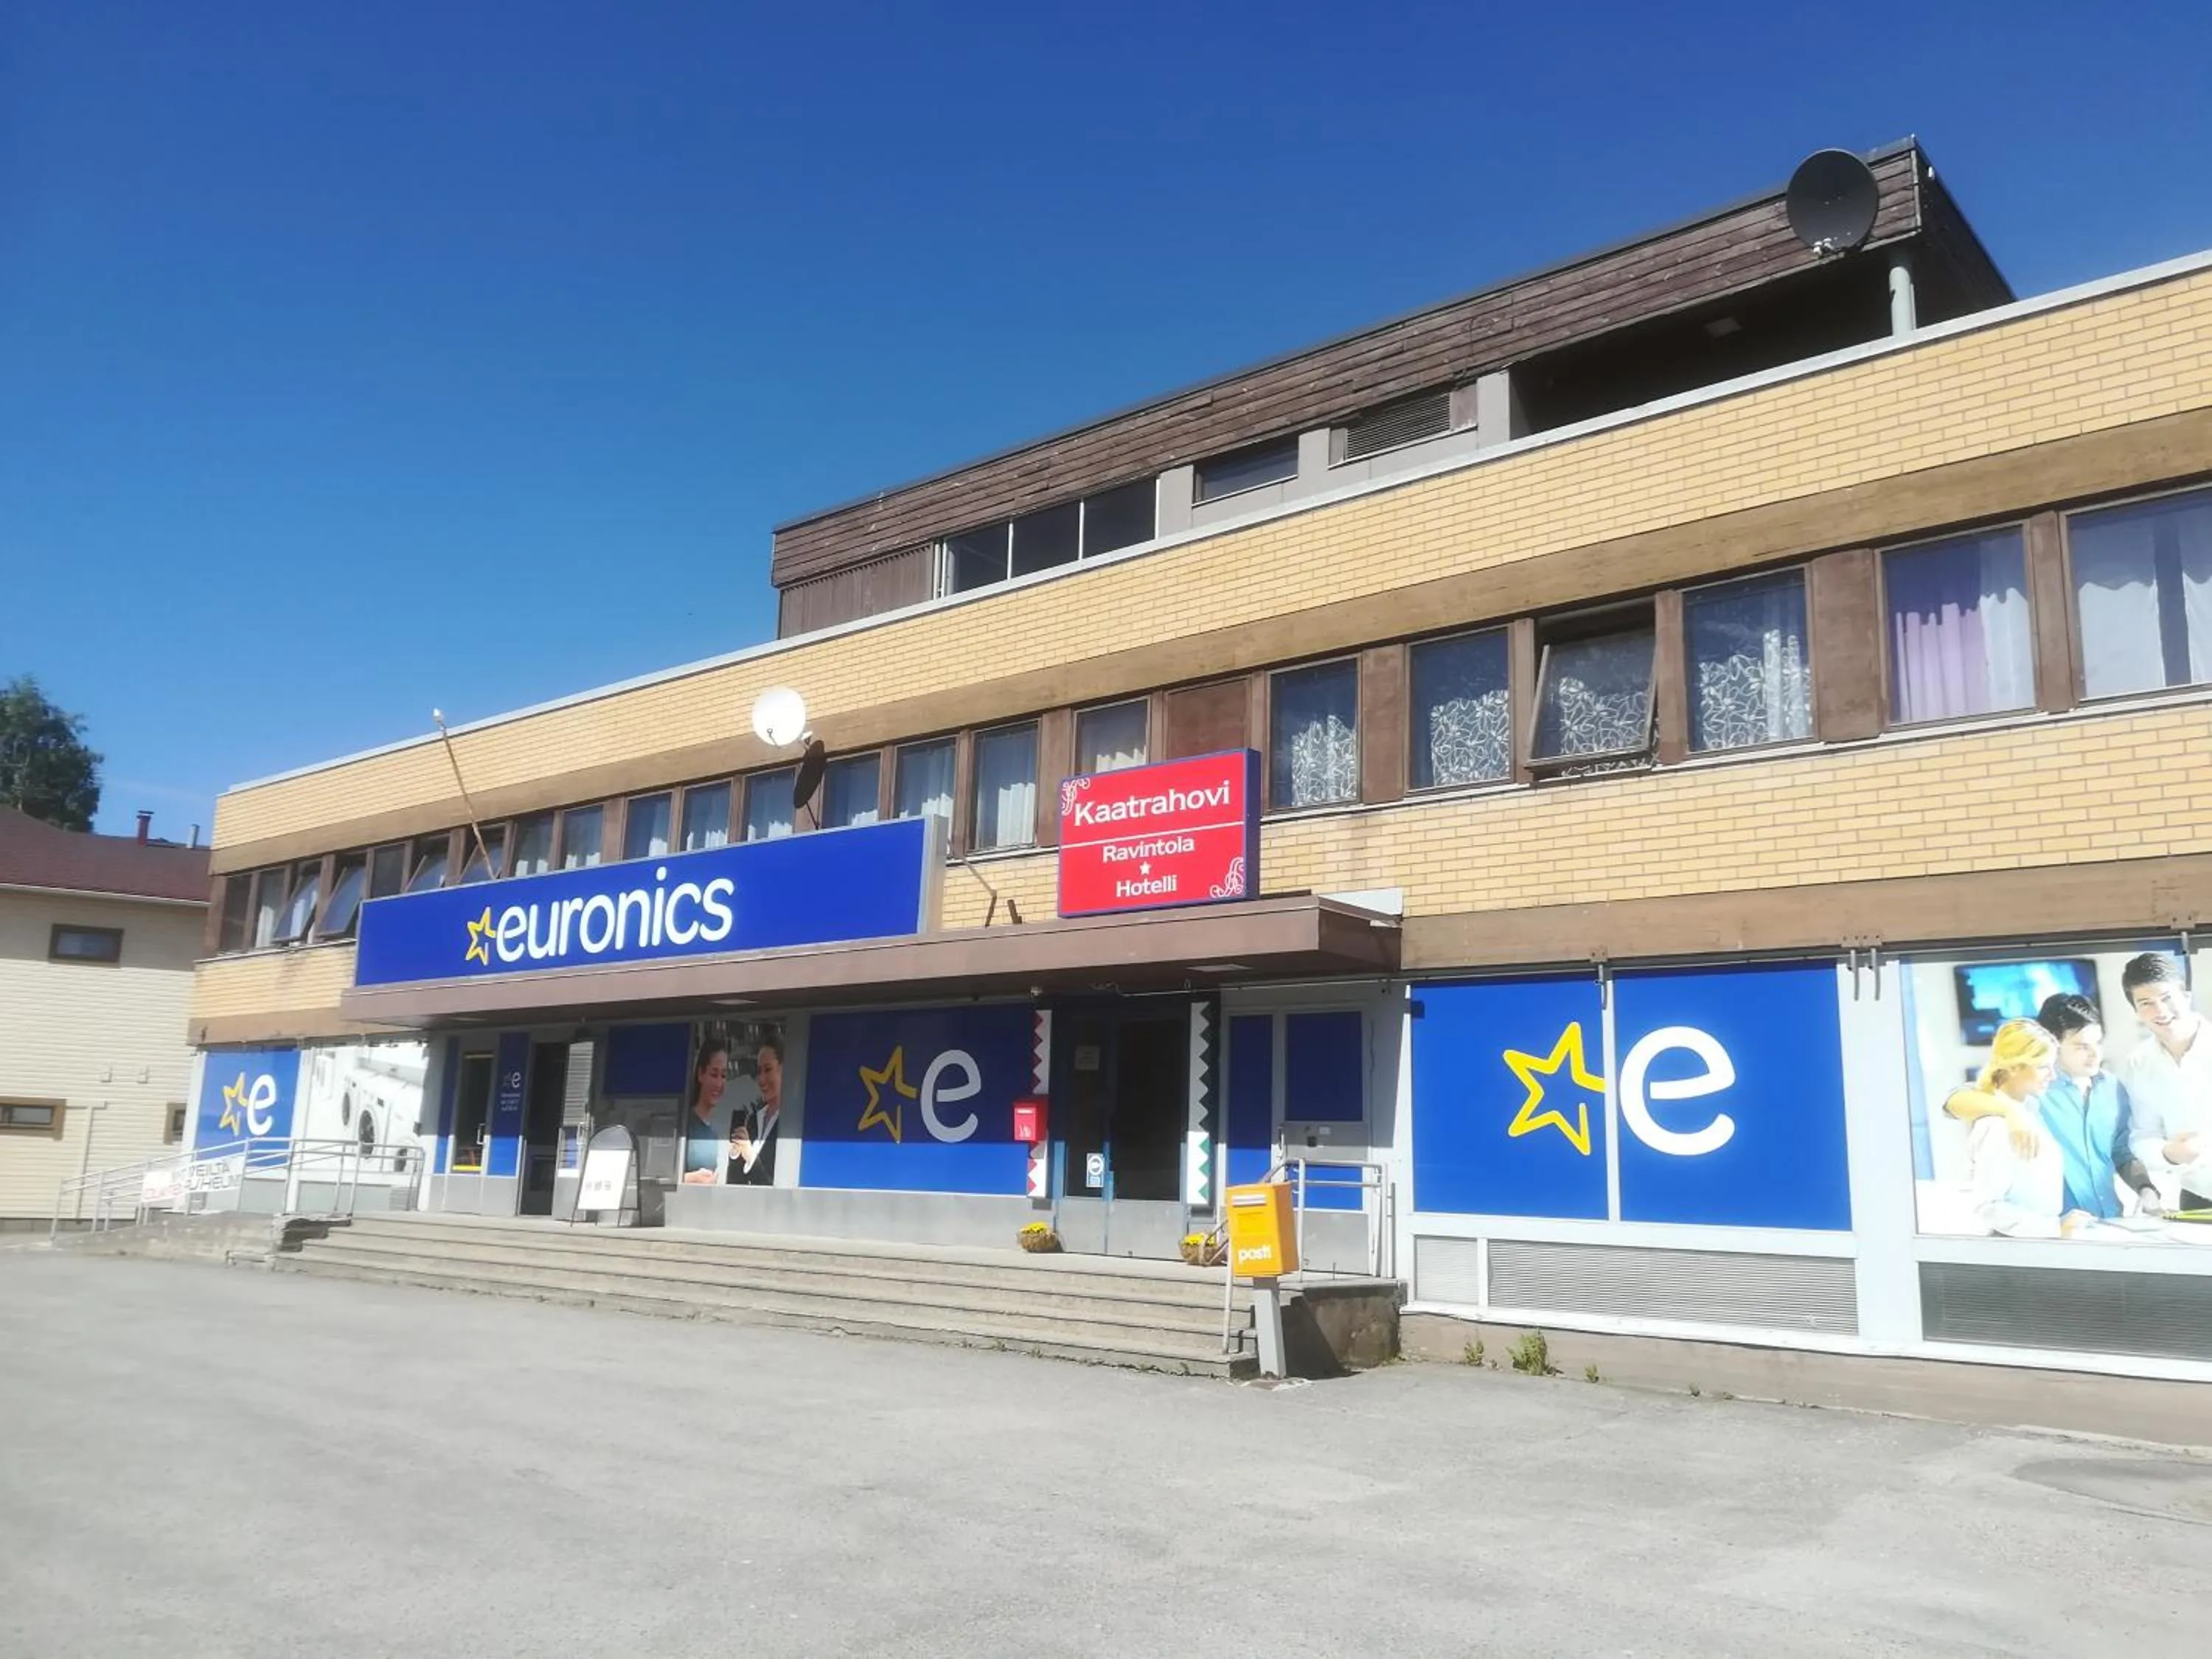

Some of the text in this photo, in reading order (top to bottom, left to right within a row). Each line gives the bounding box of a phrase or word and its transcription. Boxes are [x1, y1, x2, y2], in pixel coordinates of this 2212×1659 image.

[1074, 780, 1229, 826] Kaatrahovi
[1102, 835, 1194, 862] Ravintola
[1116, 874, 1178, 897] Hotelli
[496, 866, 734, 962] euronics
[1237, 1244, 1273, 1265] posti
